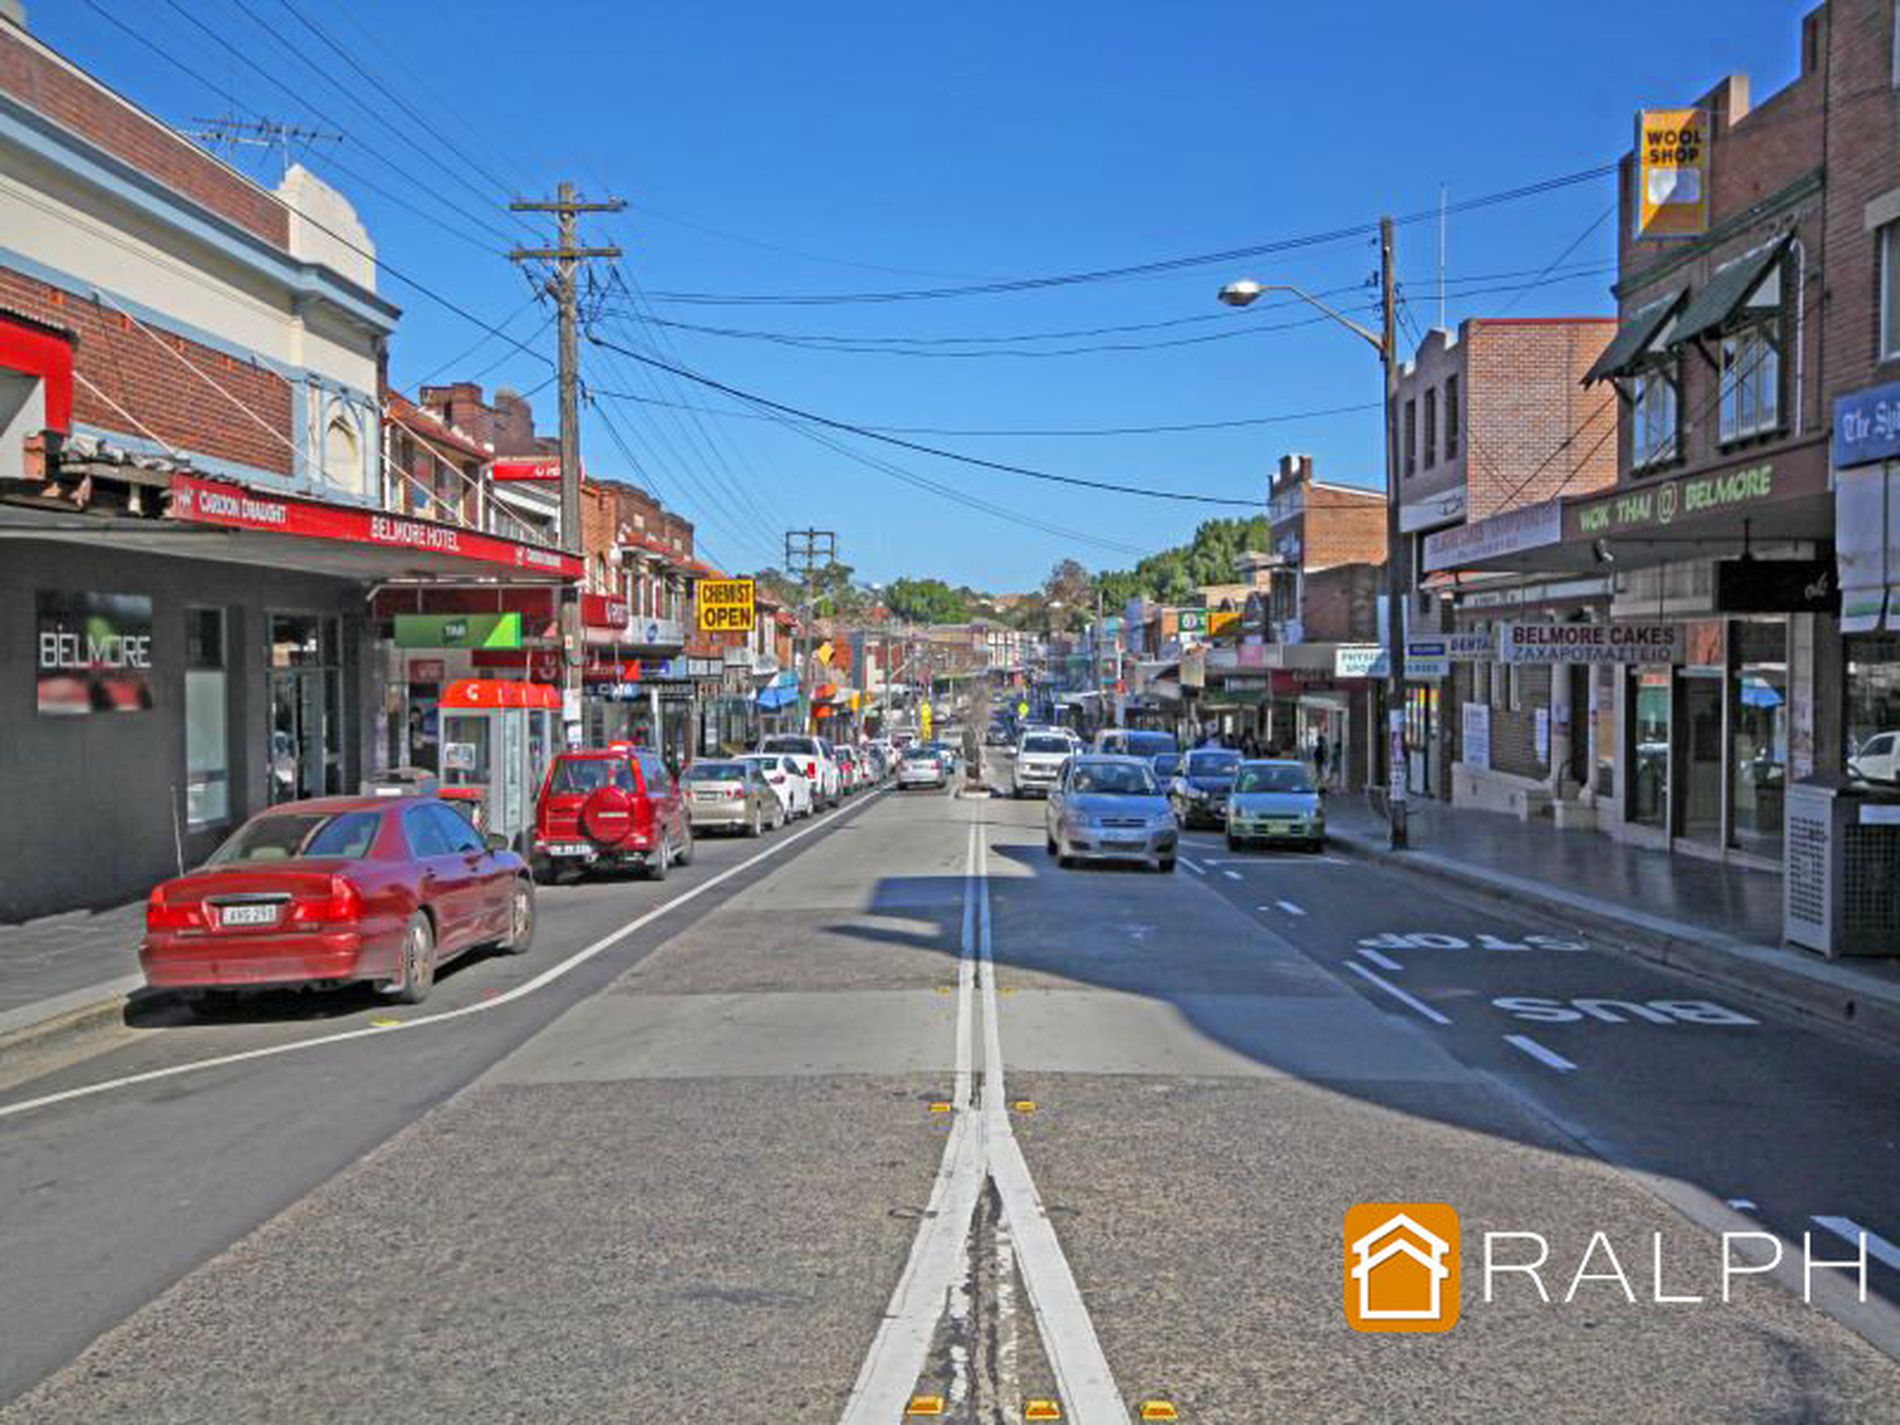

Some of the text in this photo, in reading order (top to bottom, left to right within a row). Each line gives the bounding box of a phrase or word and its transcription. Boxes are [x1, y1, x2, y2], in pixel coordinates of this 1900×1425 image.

[1647, 130, 1702, 145] WOOL
[1649, 148, 1699, 163] SHOP
[1579, 506, 1610, 532] WOK
[1616, 494, 1652, 523] THAI
[1657, 480, 1678, 524] @
[1685, 465, 1773, 512] BELMORE
[371, 515, 460, 551] BELMORE HOTEL
[703, 583, 751, 604] CHEMIST
[704, 607, 751, 628] OPEN
[1513, 626, 1676, 645] BELMORE CAKES
[40, 631, 153, 669] BELMORE
[1357, 932, 1590, 952] STOP
[1491, 996, 1762, 1026] BUS
